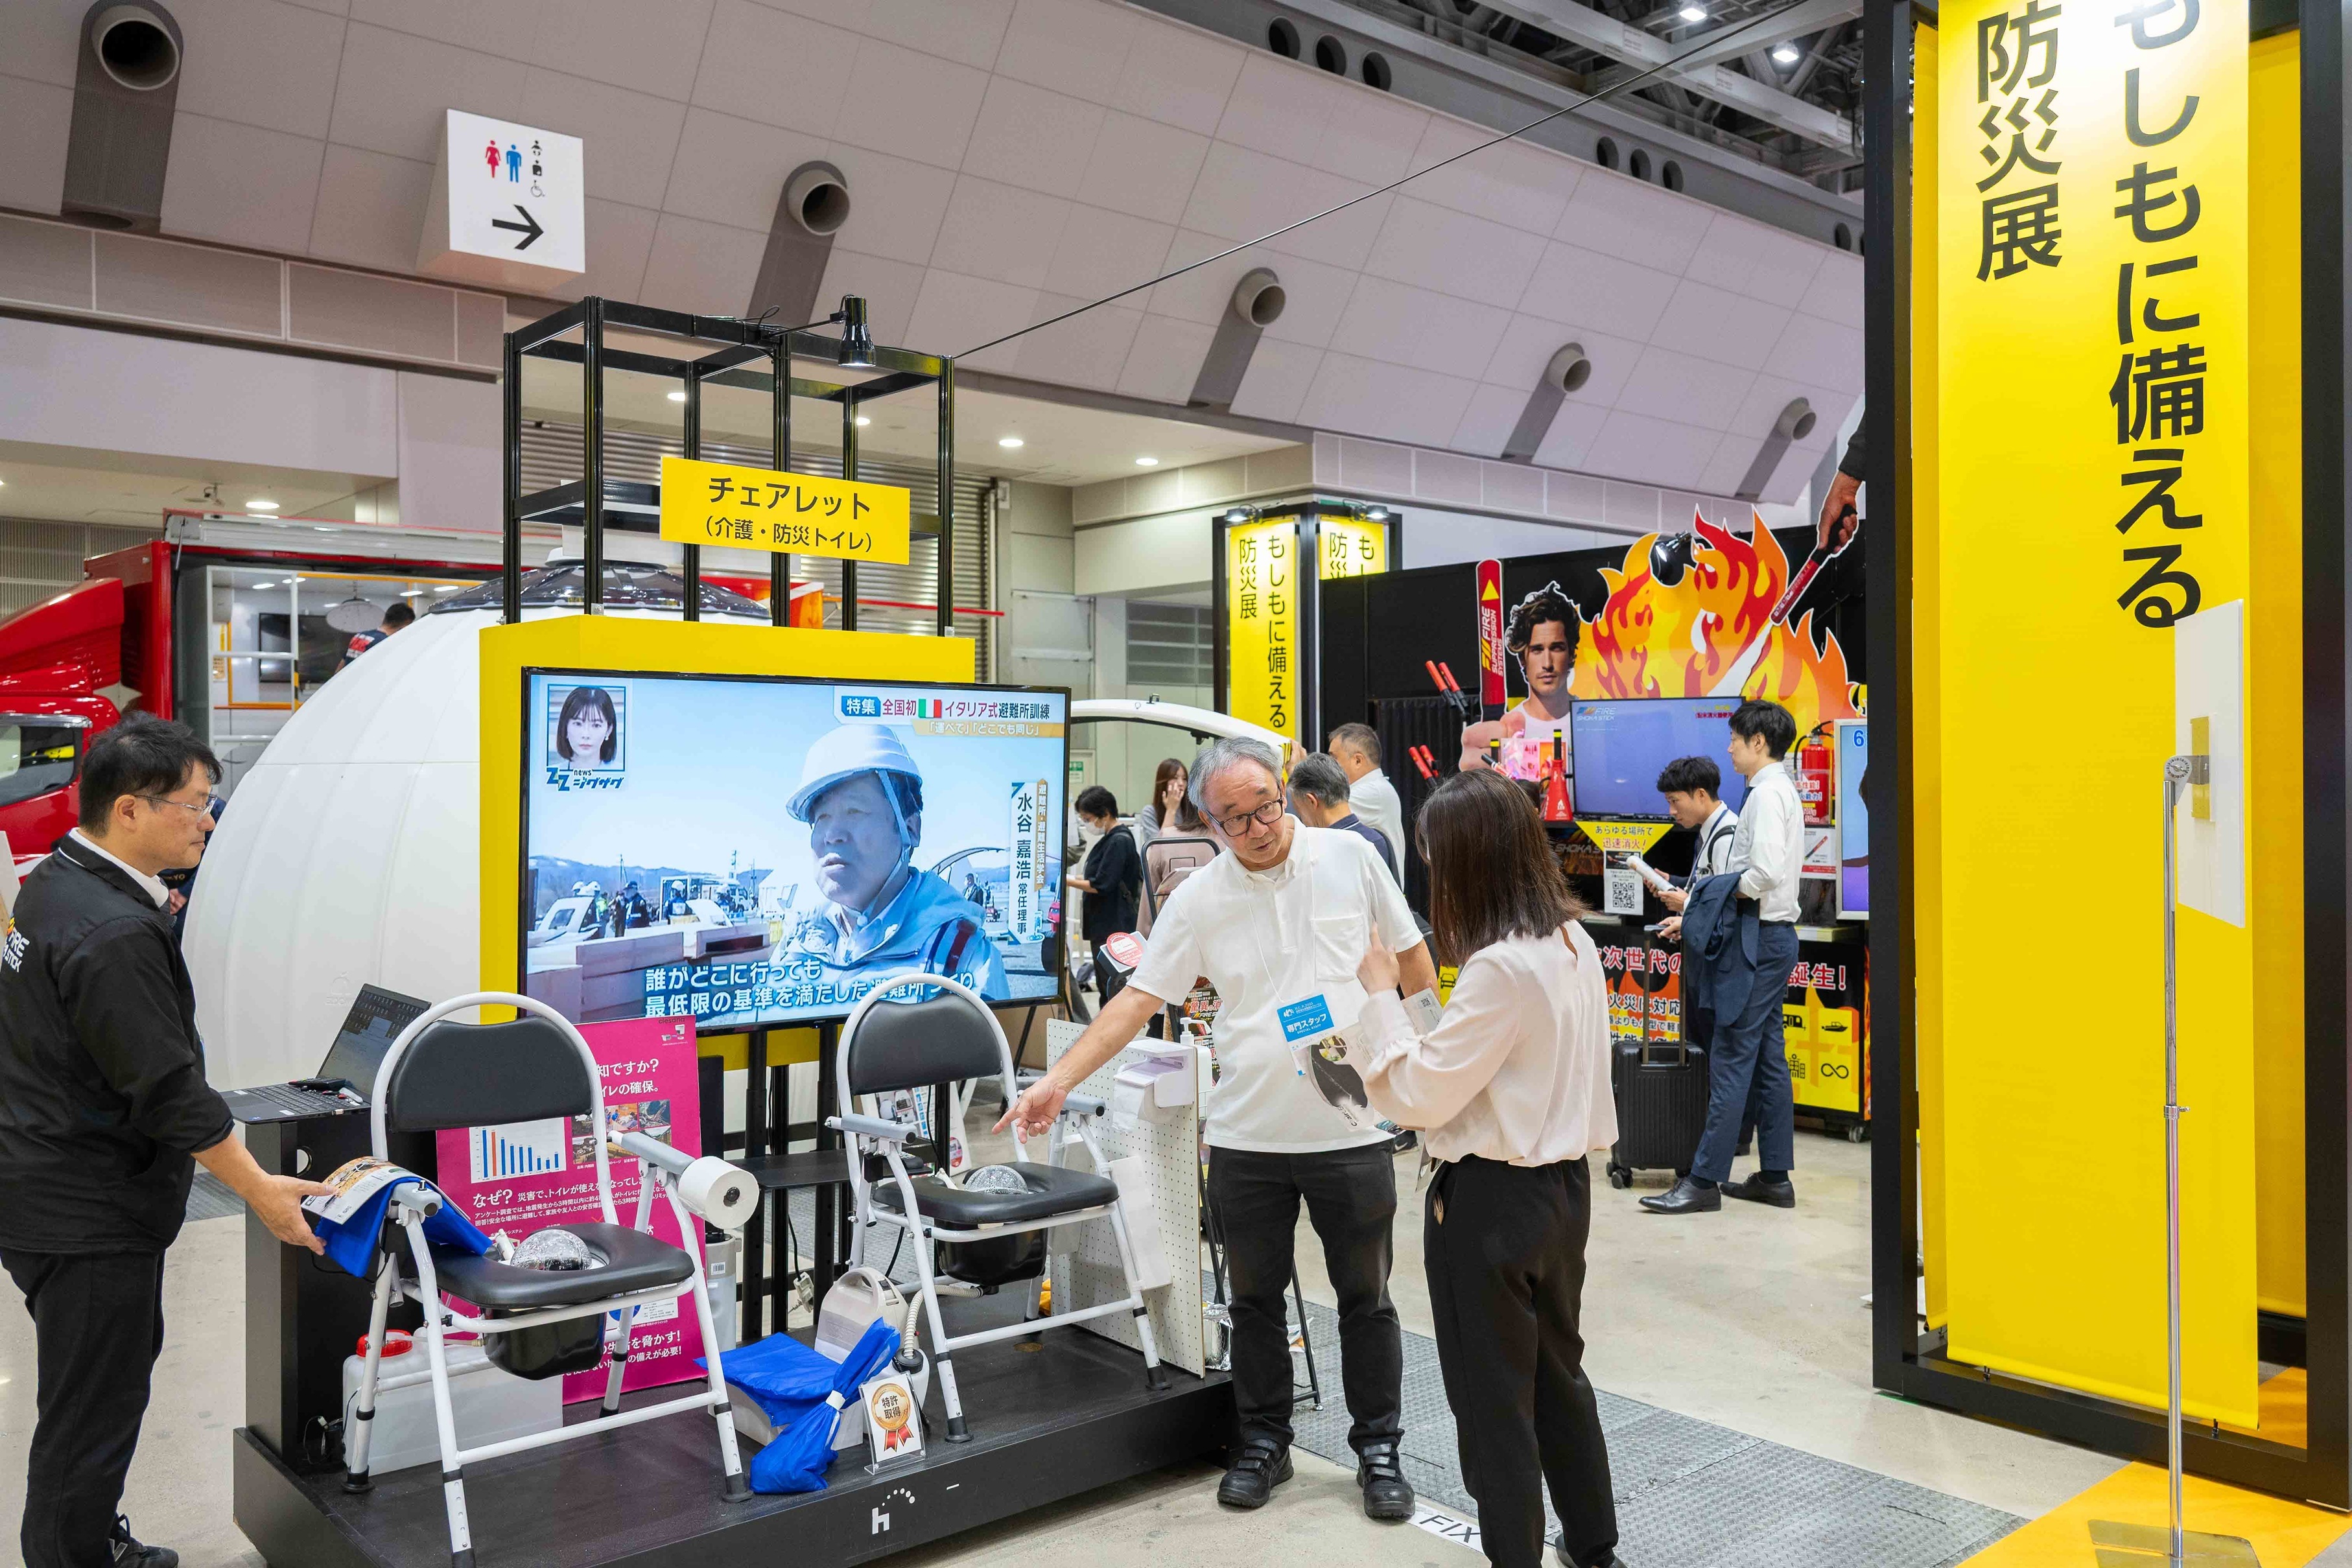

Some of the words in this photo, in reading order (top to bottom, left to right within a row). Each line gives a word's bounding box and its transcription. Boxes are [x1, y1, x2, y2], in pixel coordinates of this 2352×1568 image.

[1976, 0, 2062, 282] 防災展
[2109, 0, 2207, 628] もしもに備える
[709, 476, 871, 520] チェアレット
[706, 515, 872, 553] （介護・防災トイレ）
[1239, 539, 1257, 619] 防災展
[1267, 535, 1287, 729] もしもに備える
[1481, 605, 1491, 640] FIRE
[847, 698, 875, 715] 特集
[882, 699, 916, 716] 全国初
[945, 701, 1050, 720] イタリア式避難所訓練
[573, 777, 624, 789] ジグザグ
[1017, 792, 1033, 833] 水谷
[1016, 839, 1031, 879] 嘉浩
[1017, 882, 1028, 934] 常任理事
[646, 960, 821, 992] 誰がどこに行っても
[1597, 945, 1681, 975] 次世代の
[1286, 1013, 1326, 1033] 専門スタッフ
[473, 1189, 513, 1208] なぜ？
[882, 1396, 898, 1408] 特許
[884, 1406, 901, 1419] 取得
